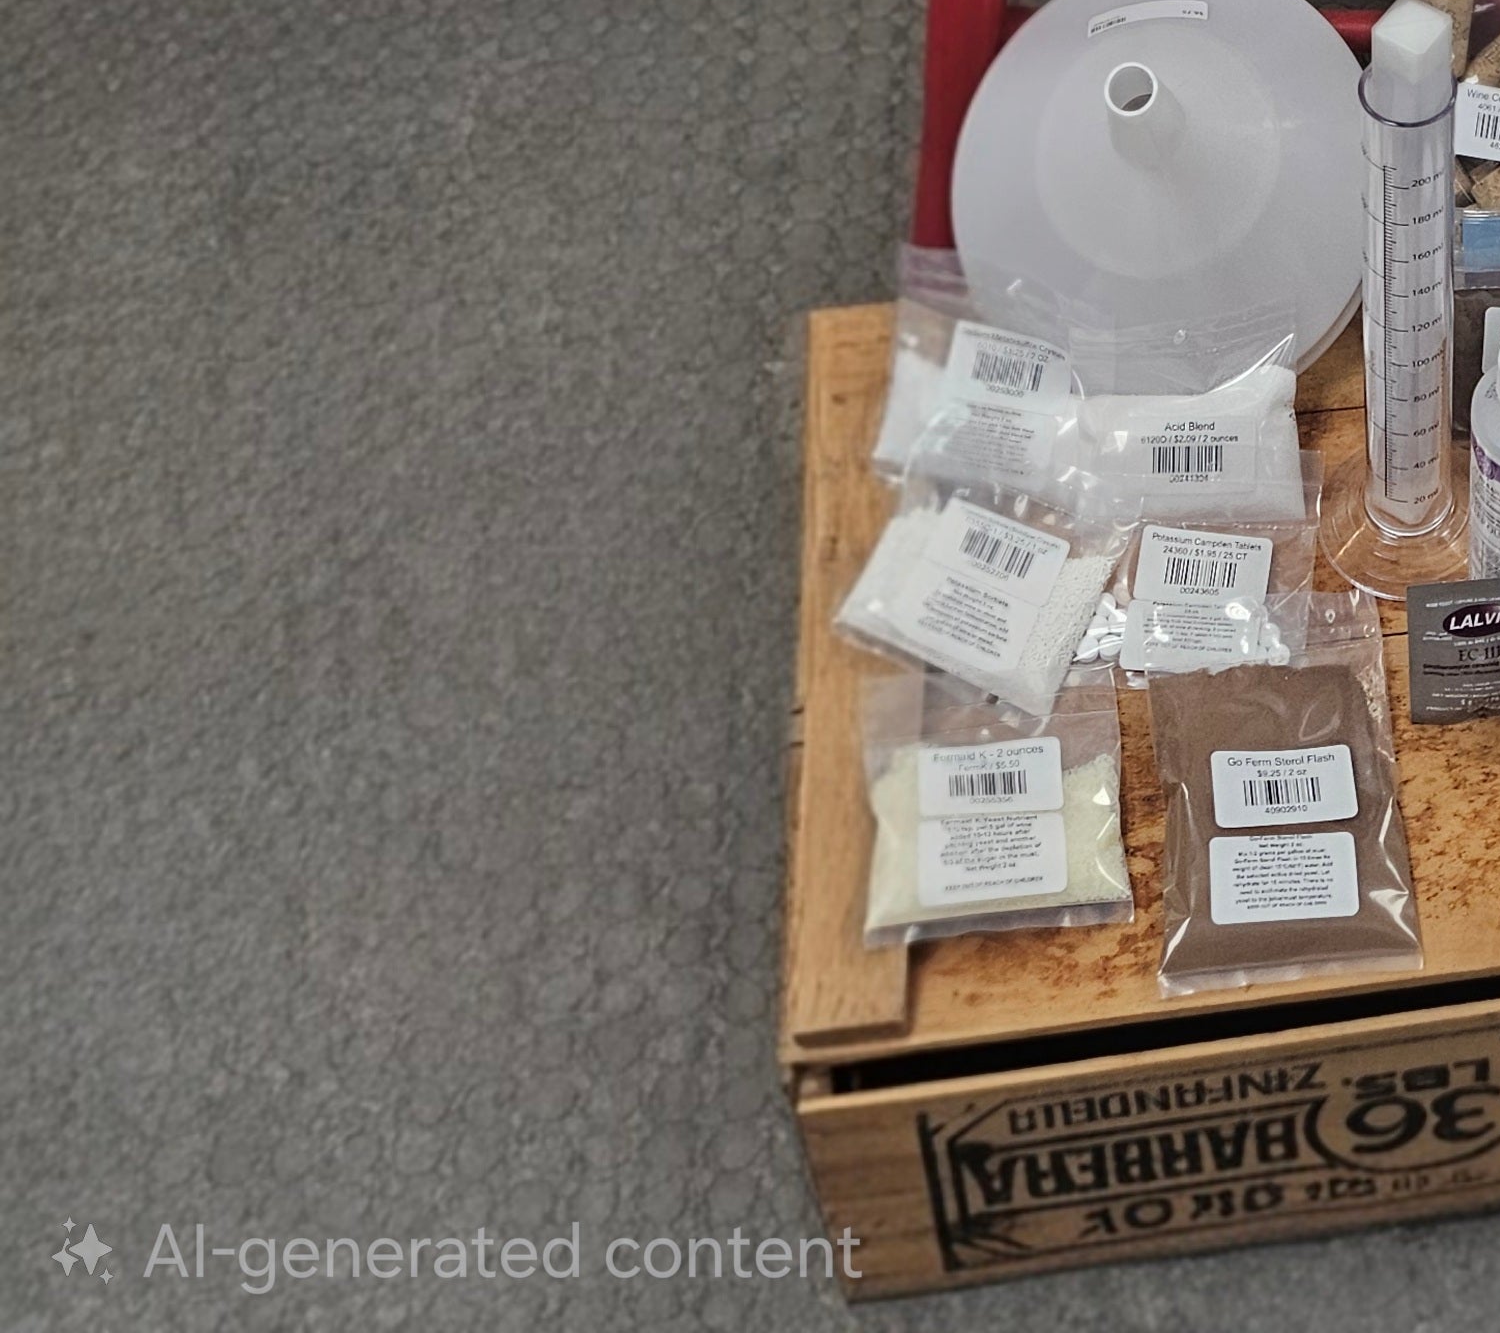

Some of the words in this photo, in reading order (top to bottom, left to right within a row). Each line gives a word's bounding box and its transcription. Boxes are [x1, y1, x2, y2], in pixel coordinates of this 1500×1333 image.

[1467, 89, 1489, 101] Wine
[1411, 176, 1431, 188] 200
[1413, 214, 1431, 225] 180
[1413, 250, 1431, 262] 160
[1412, 285, 1431, 297] 140
[1412, 321, 1430, 332] 120
[1412, 357, 1430, 368] 100
[1414, 391, 1427, 403] 80
[1164, 422, 1186, 432] Acid
[1188, 421, 1215, 431] Blend
[1413, 426, 1427, 437] 60
[1174, 434, 1196, 444] $2.09
[1203, 434, 1208, 443] 2
[1211, 435, 1238, 443] ounces
[1413, 459, 1426, 469] 40
[1414, 493, 1426, 504] 20
[1152, 532, 1193, 545] Potassium
[1194, 537, 1232, 549] Campden
[1234, 541, 1262, 552] Tablets
[1163, 545, 1189, 555] 24360
[1194, 548, 1217, 558] $1.95
[1223, 551, 1233, 559] 25
[979, 750, 987, 760] K
[997, 748, 1004, 758] 2
[1006, 745, 1044, 757] ounces
[1227, 757, 1242, 766] Go
[1245, 757, 1271, 766] Ferm
[1275, 755, 1304, 766] Sterol
[1307, 754, 1335, 763] Flash
[1257, 769, 1281, 777] $9.25
[1341, 1057, 1489, 1100] LBS.
[960, 1113, 1299, 1207] BARBERA
